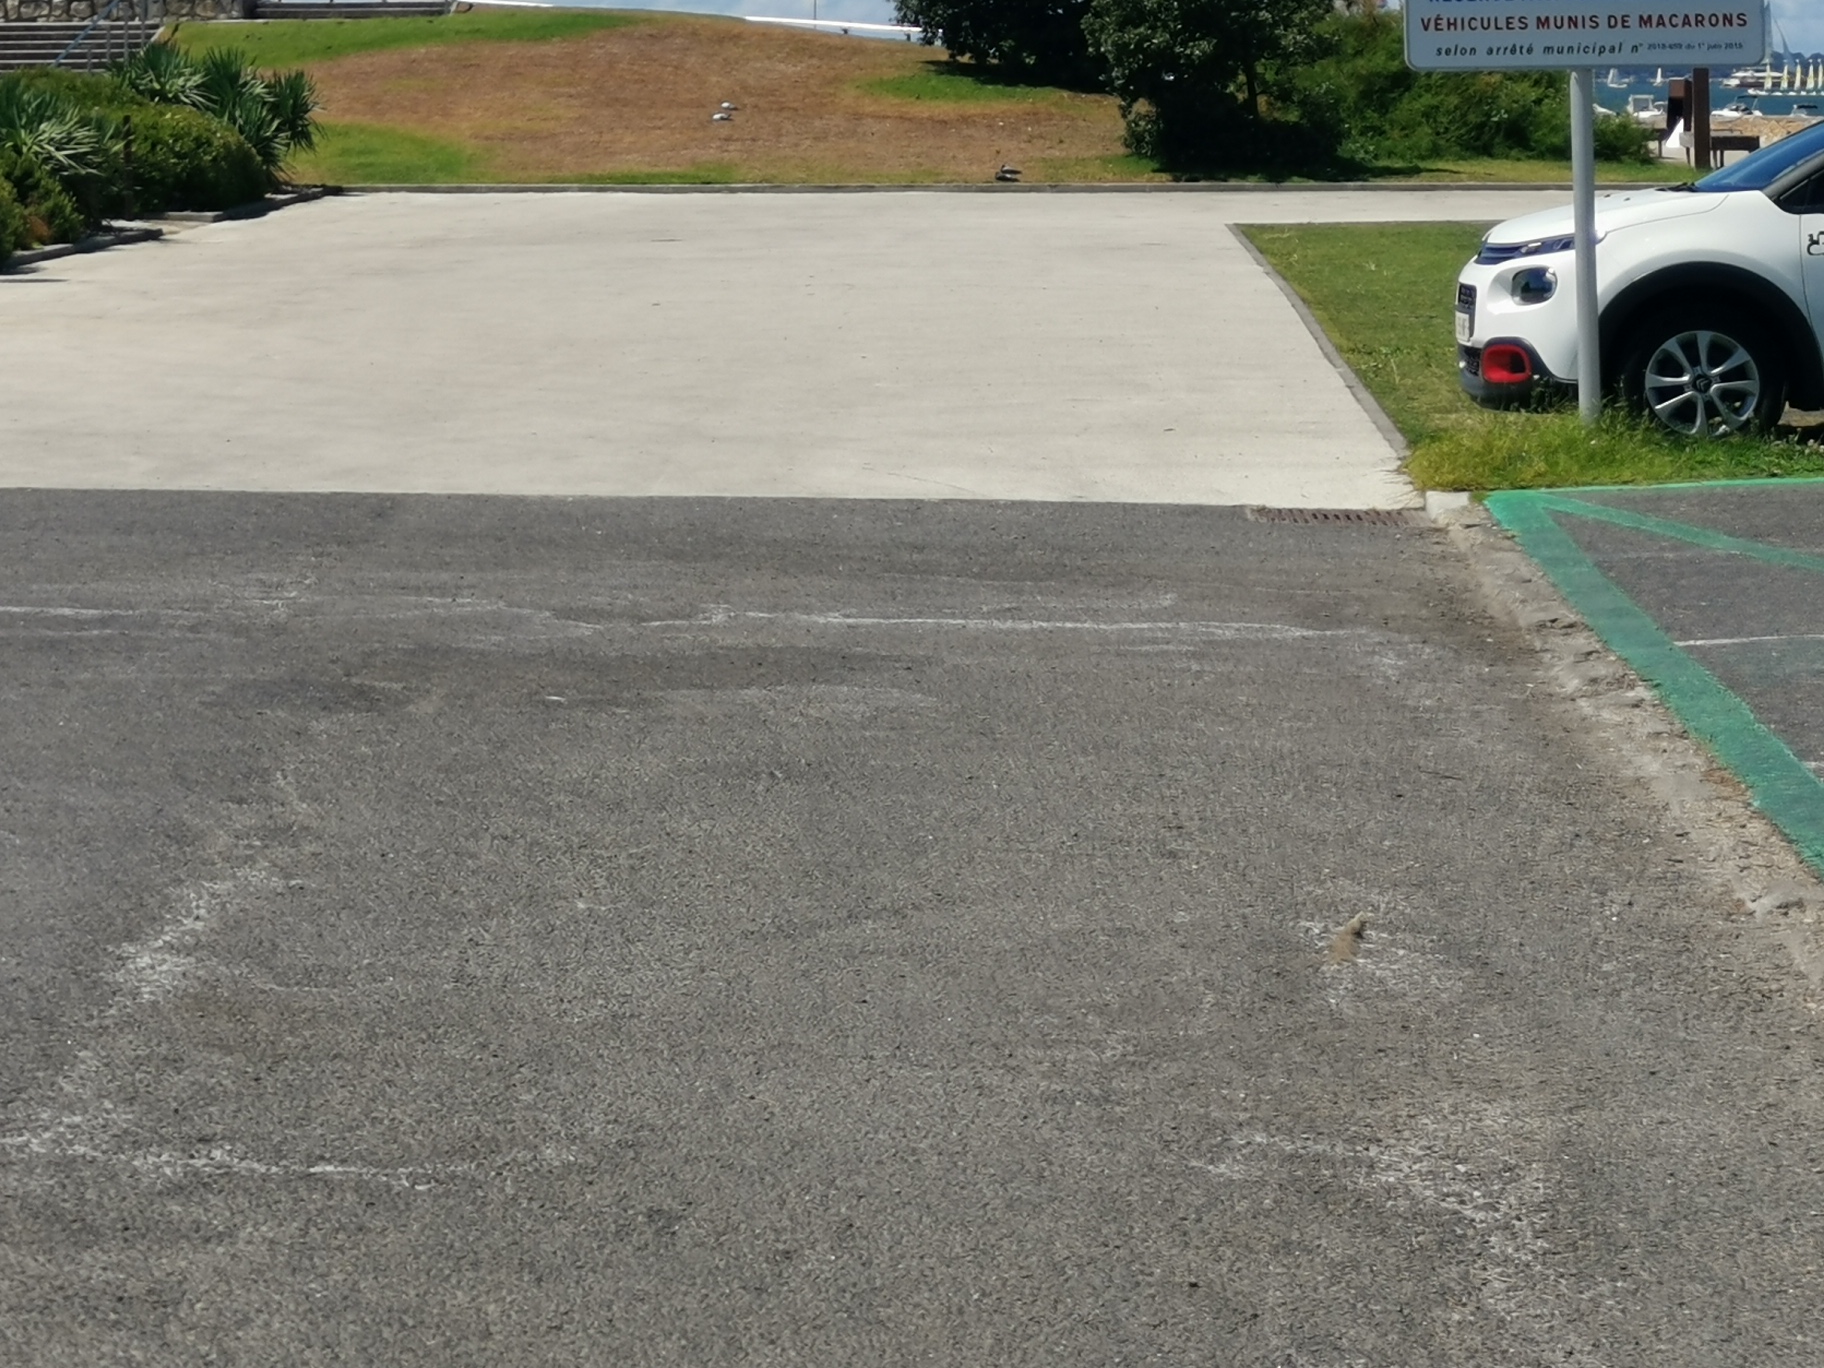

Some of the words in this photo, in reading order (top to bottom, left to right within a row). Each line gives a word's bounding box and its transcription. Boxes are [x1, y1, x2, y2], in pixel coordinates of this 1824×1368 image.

[1420, 14, 1529, 32] VÉHICULES
[1536, 15, 1600, 30] MUNIS
[1607, 14, 1631, 29] DE
[1638, 13, 1748, 29] MACARONS
[1435, 44, 1477, 57] selon
[1486, 43, 1534, 56] arrêté
[1542, 42, 1623, 57] municipal
